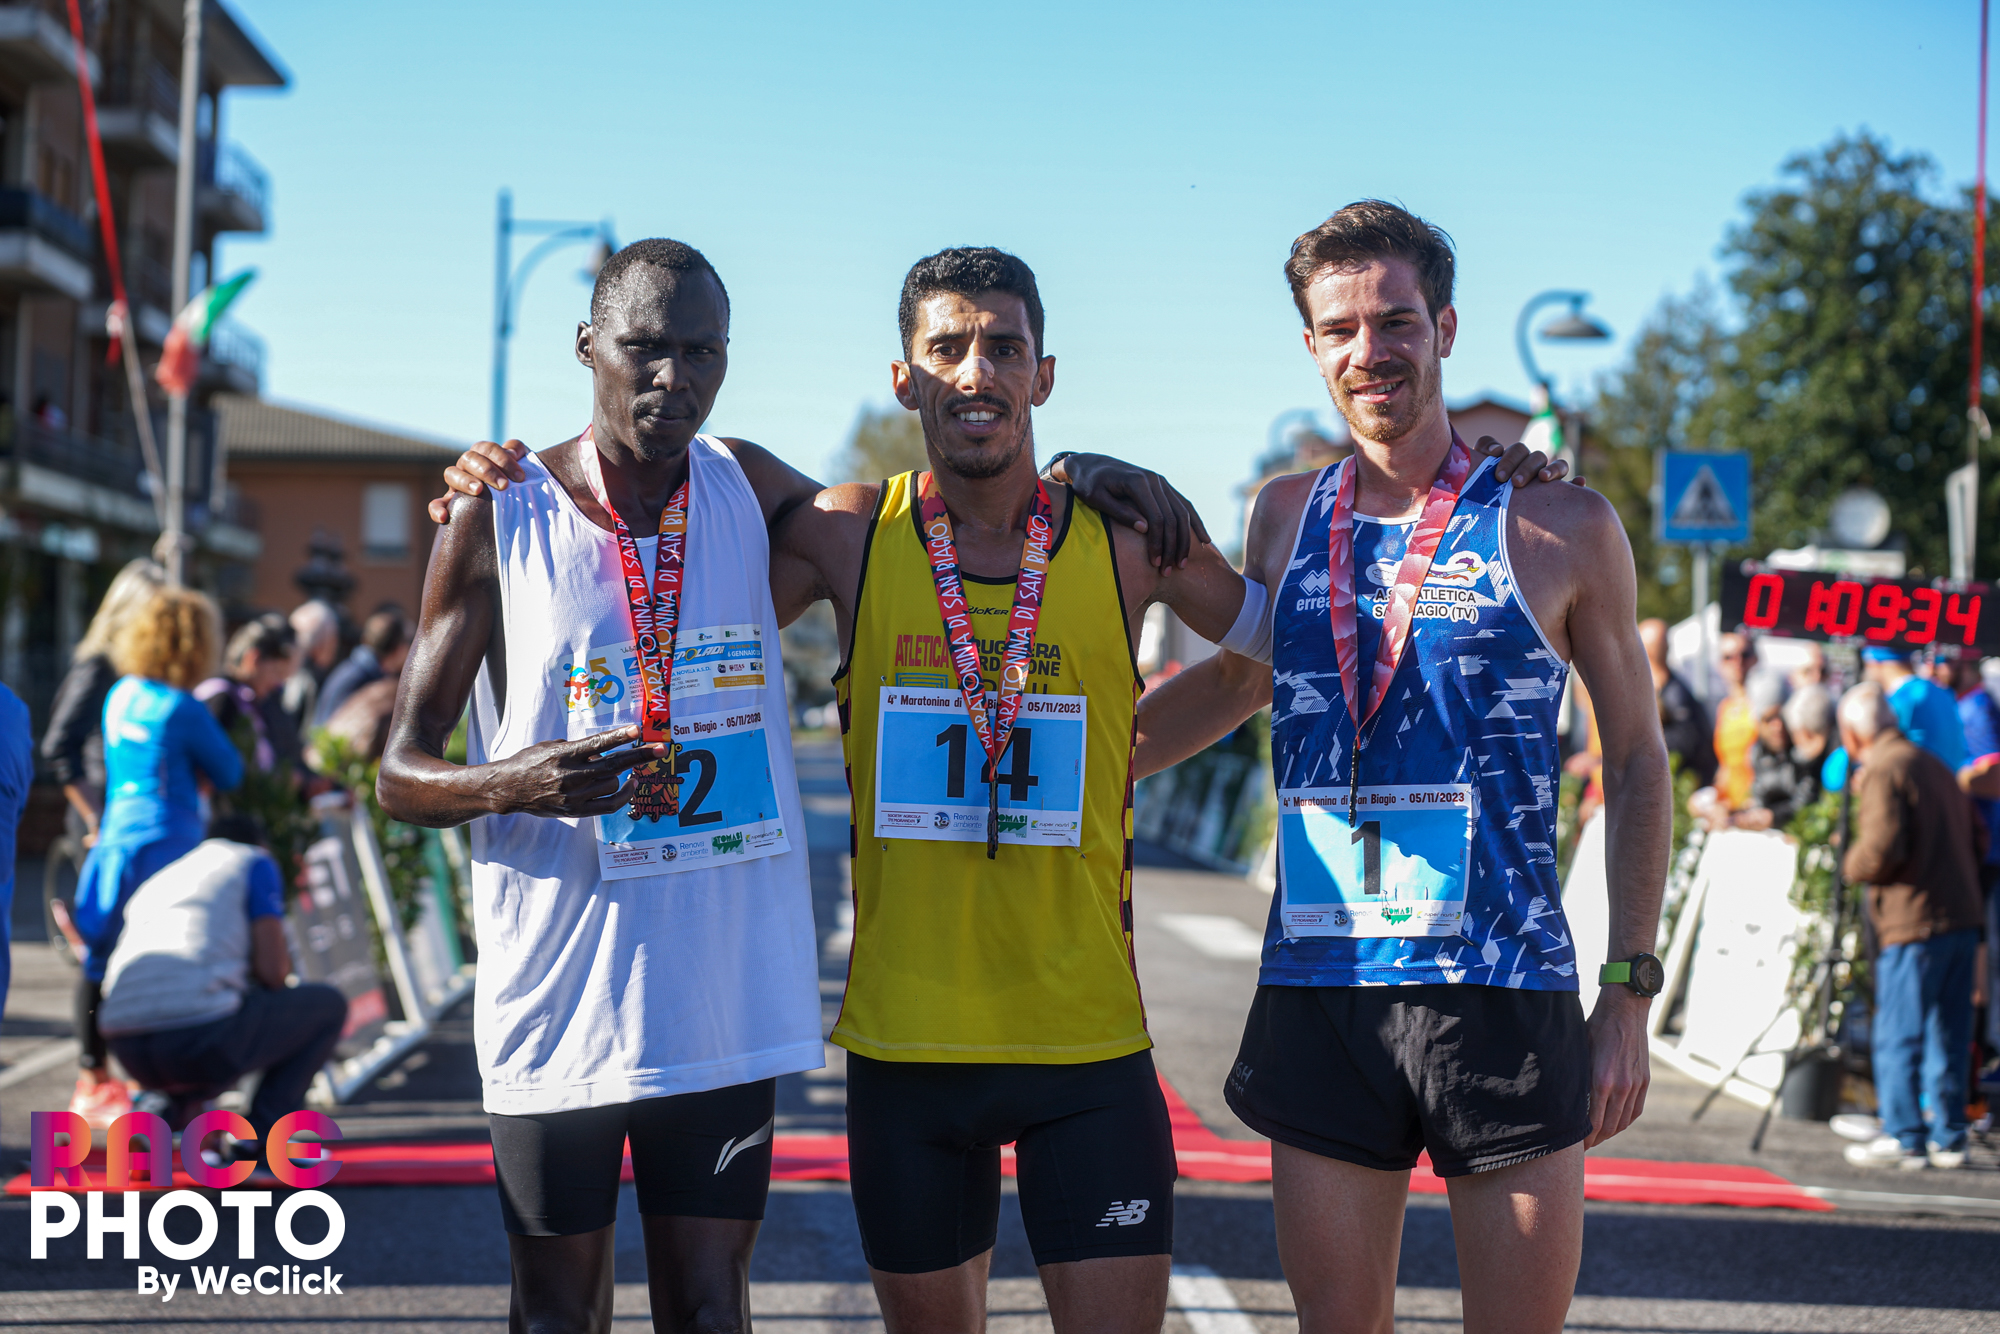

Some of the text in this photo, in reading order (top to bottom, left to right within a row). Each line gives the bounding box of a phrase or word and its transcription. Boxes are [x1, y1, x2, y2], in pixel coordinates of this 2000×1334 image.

[621, 536, 642, 569] SAN
[660, 531, 682, 563] SAN
[629, 574, 646, 588] DI
[658, 569, 679, 583] DI
[1451, 606, 1477, 622] (TV)
[929, 523, 992, 750] MARATONINA DI SAN BIAGIO
[995, 514, 1049, 742] MARATONINA DI SAN BIAGIO
[632, 594, 668, 712] MARATONINA
[895, 634, 949, 668] ATLETICA
[900, 695, 950, 707] Maratonina
[954, 696, 962, 707] di
[1027, 701, 1082, 713] 05/11/2023
[673, 725, 690, 735] San
[693, 720, 718, 734] Biagio
[936, 724, 1039, 801] 14
[676, 749, 723, 828] 2
[1293, 796, 1337, 807] Maratonina
[1340, 795, 1349, 805] di
[1370, 793, 1396, 806] Biagio
[1409, 792, 1465, 803] 05/11/2023
[953, 812, 979, 821] Renova
[953, 820, 982, 829] ambiente
[997, 814, 1028, 823] OMASI
[680, 840, 704, 850] Renova
[680, 847, 709, 857] ambiente
[1351, 820, 1381, 894] 1
[1095, 1199, 1150, 1227] NB
